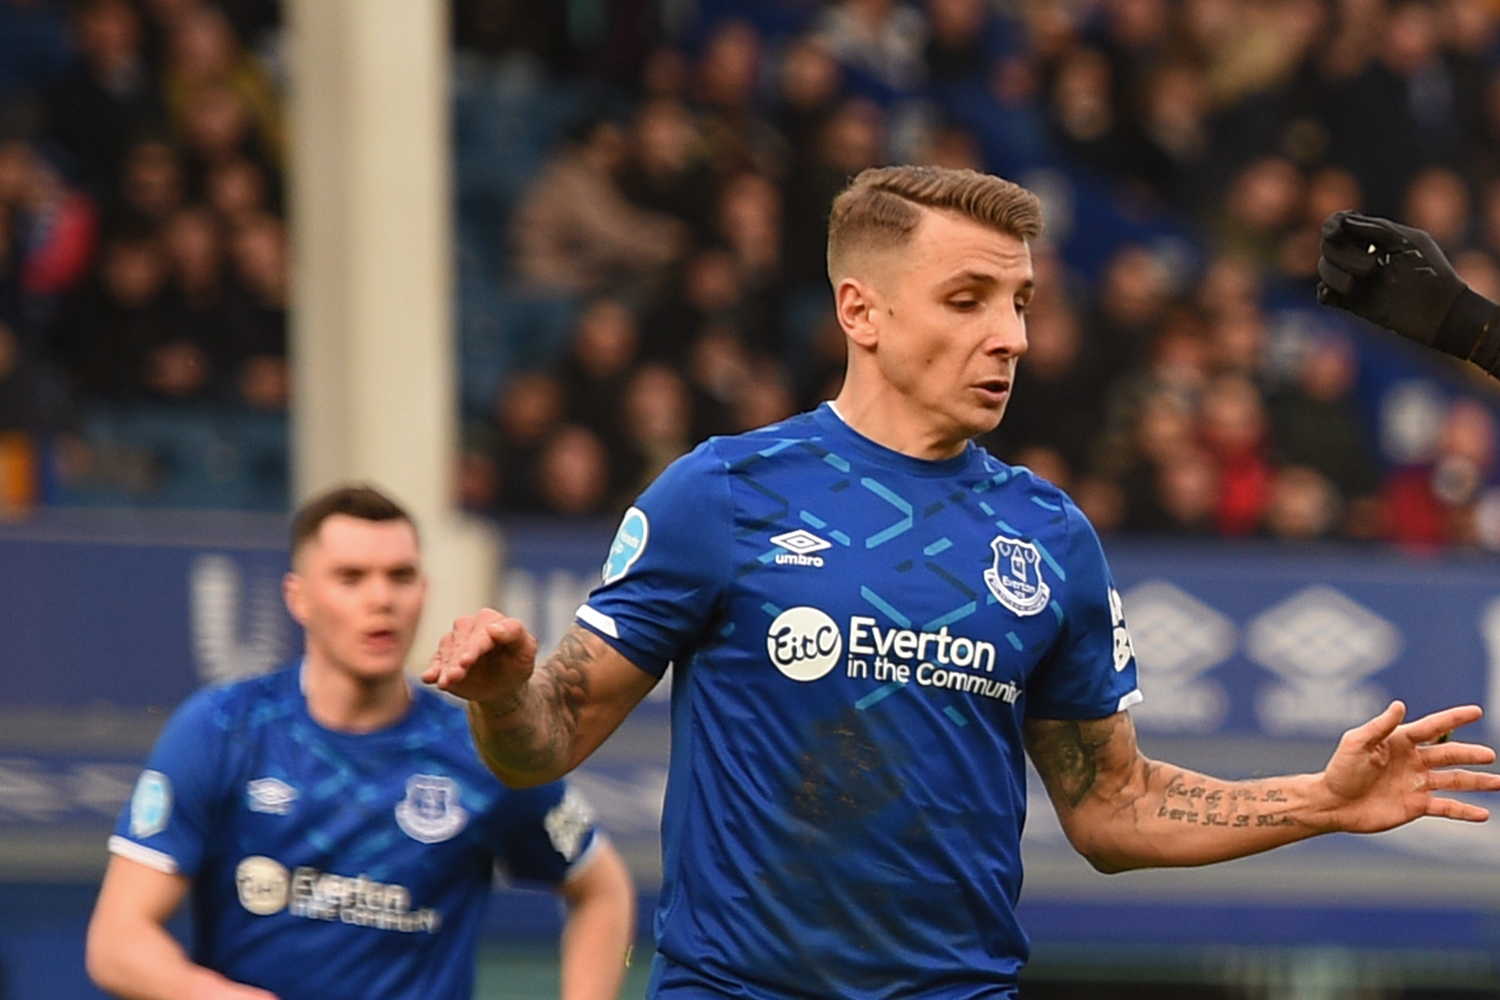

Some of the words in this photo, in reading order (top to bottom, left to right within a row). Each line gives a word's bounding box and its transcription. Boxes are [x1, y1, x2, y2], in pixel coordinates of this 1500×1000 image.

[775, 553, 825, 568] umbro
[850, 616, 996, 672] Everton
[847, 654, 868, 679] in
[874, 656, 911, 683] the
